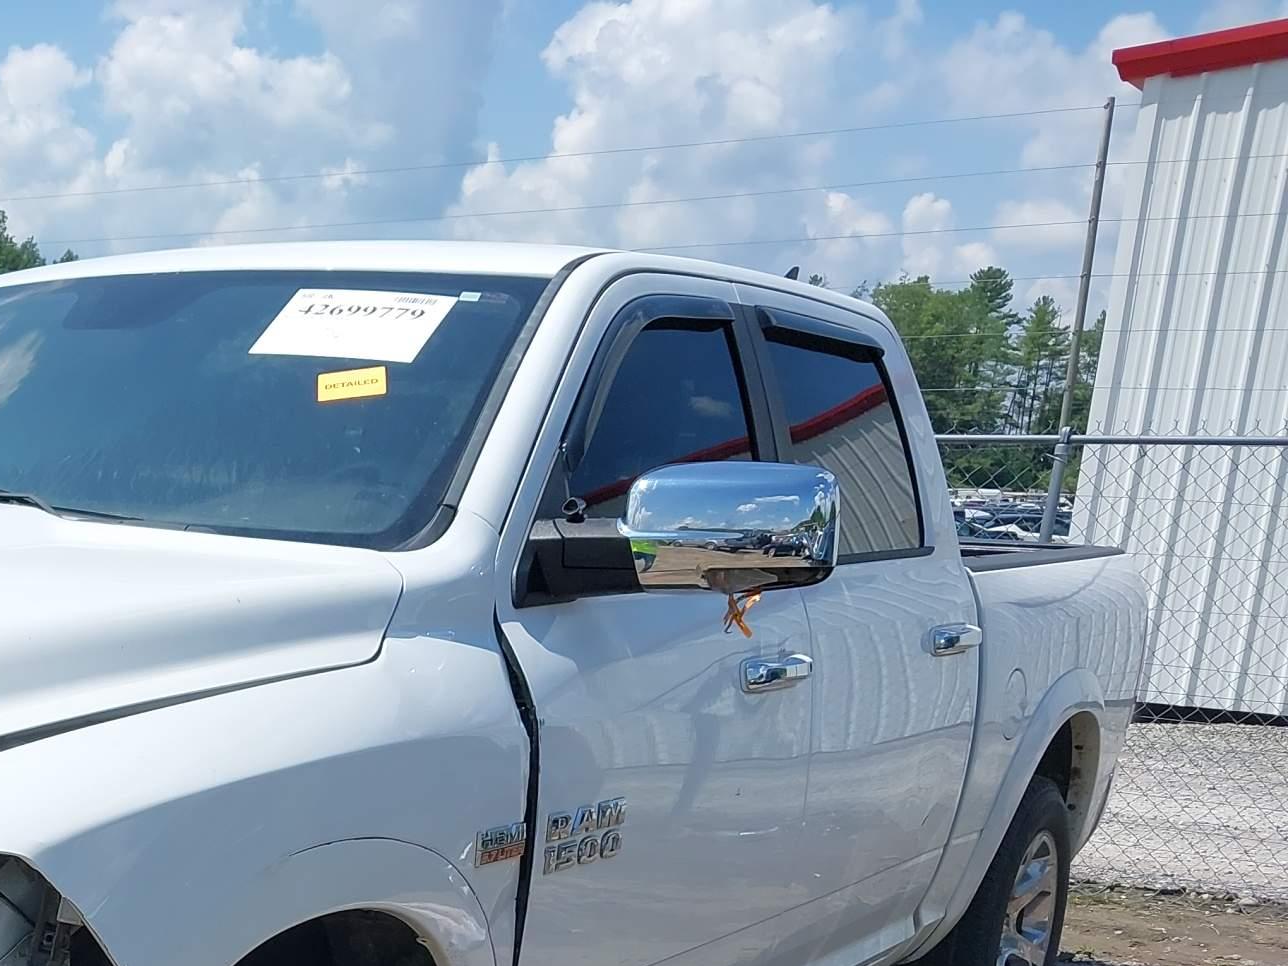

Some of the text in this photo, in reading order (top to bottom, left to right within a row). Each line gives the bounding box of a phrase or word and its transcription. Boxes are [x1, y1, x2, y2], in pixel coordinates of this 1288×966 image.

[298, 303, 426, 320] 42699779
[324, 378, 379, 390] DETAILED
[546, 797, 627, 843] RAM
[481, 823, 526, 850] HEMI
[543, 828, 623, 875] 1500
